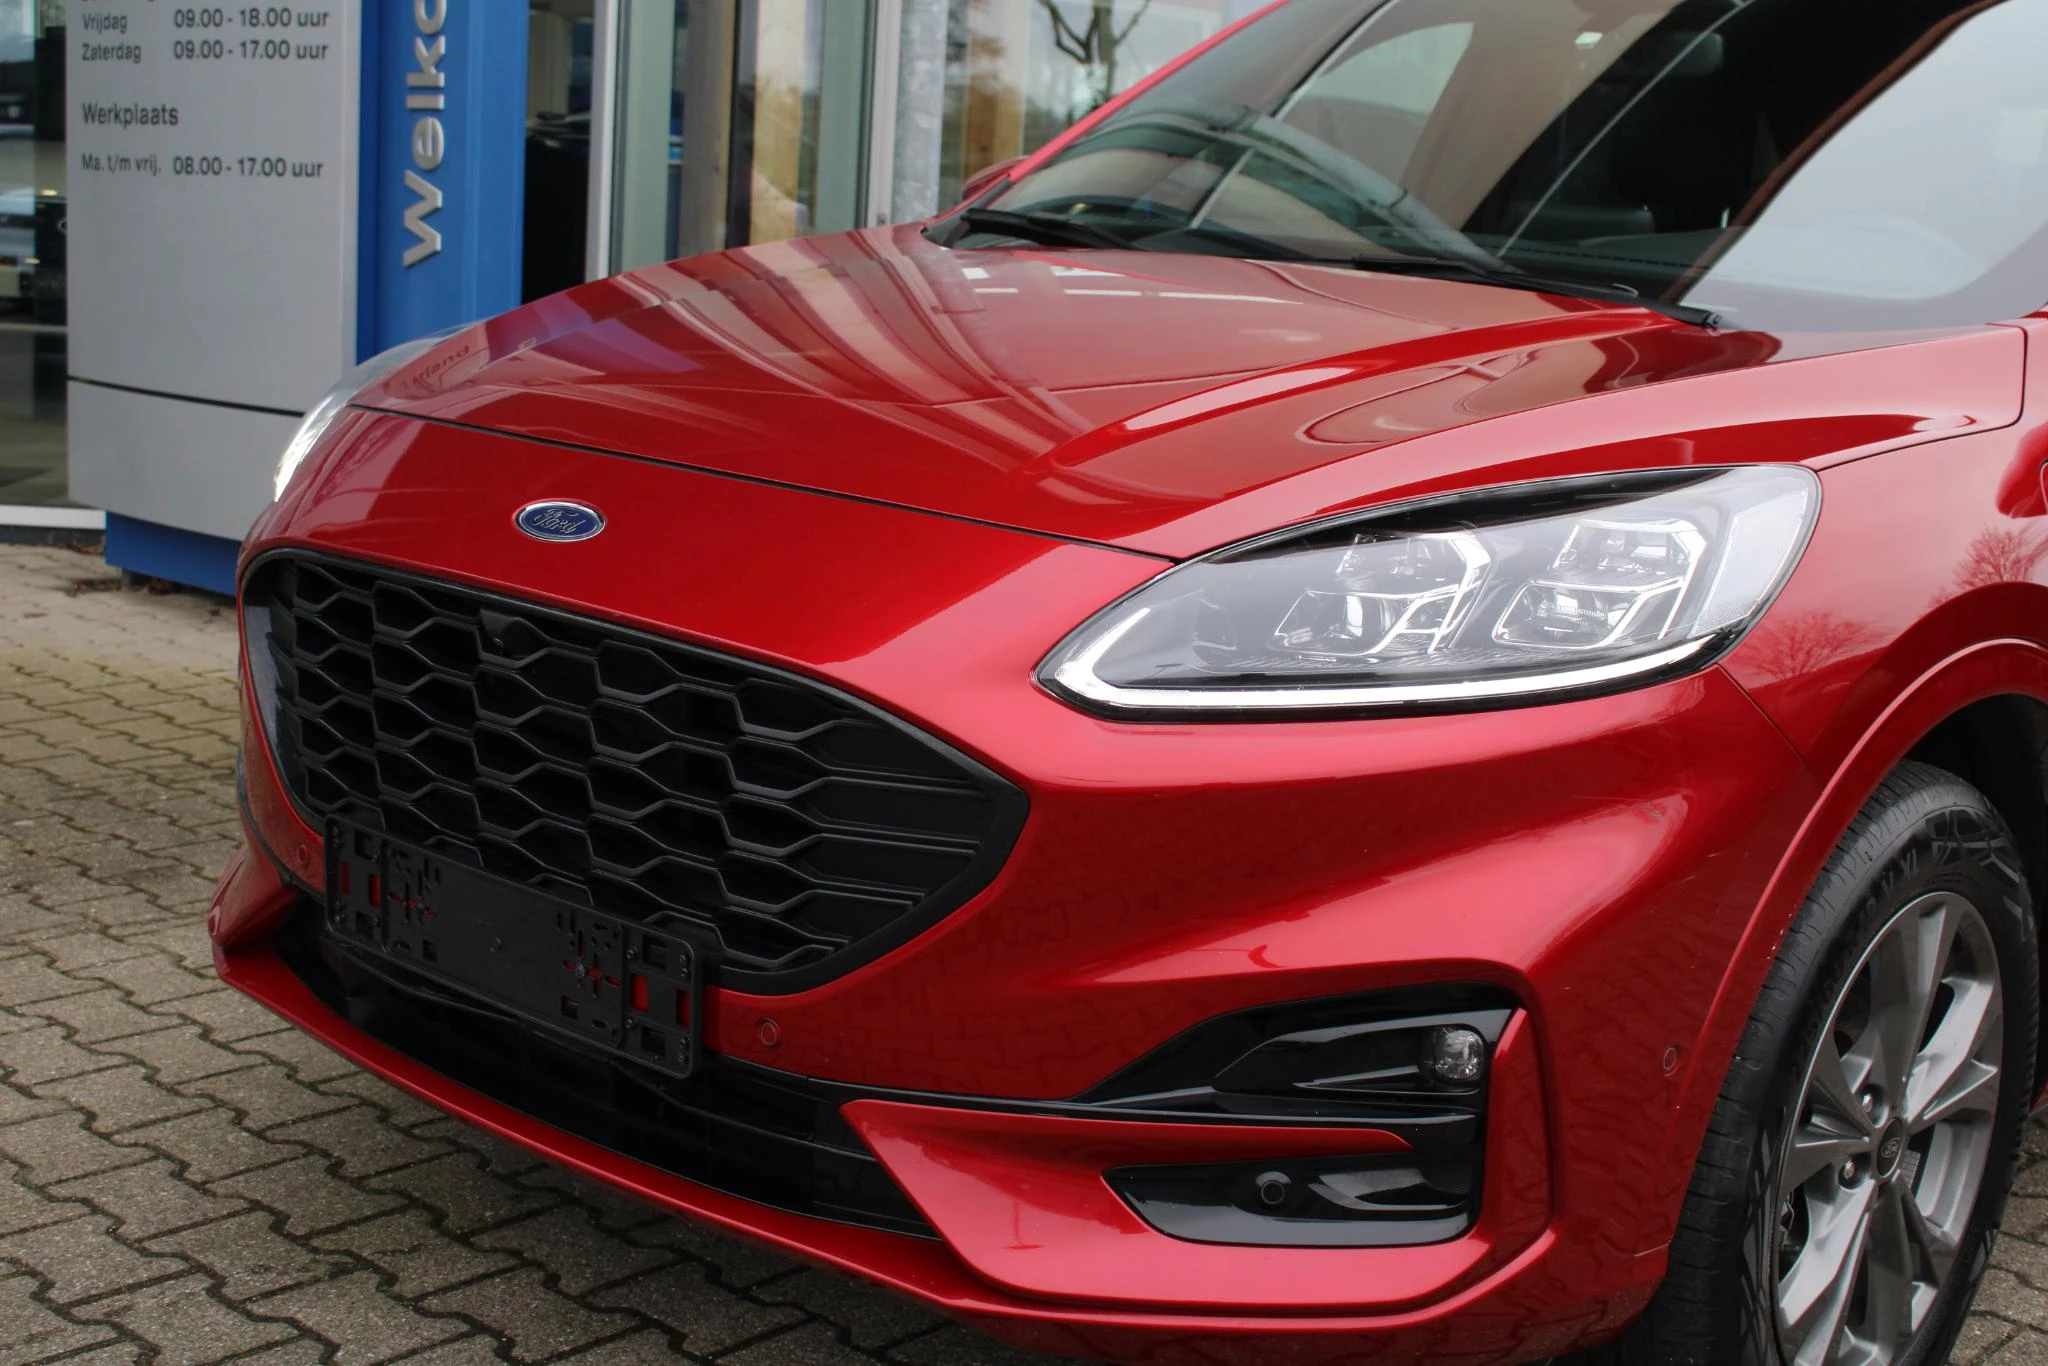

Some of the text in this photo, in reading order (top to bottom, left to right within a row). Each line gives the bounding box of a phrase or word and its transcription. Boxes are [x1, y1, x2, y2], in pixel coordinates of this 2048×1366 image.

[82, 13, 128, 33] Vrijdag
[174, 9, 223, 28] 09.00
[239, 8, 292, 27] 18.00
[297, 12, 329, 27] uur
[82, 42, 142, 64] Zaterdag
[174, 40, 223, 59] 09.00
[240, 40, 291, 60] 17.00
[296, 43, 328, 59] uur
[82, 103, 179, 129] Werkplaats
[81, 153, 104, 171] Ma.
[107, 155, 132, 173] t/m
[135, 154, 162, 176] vrij.
[173, 156, 222, 175] 08.00
[238, 157, 287, 177] 17.00
[291, 161, 324, 177] uur
